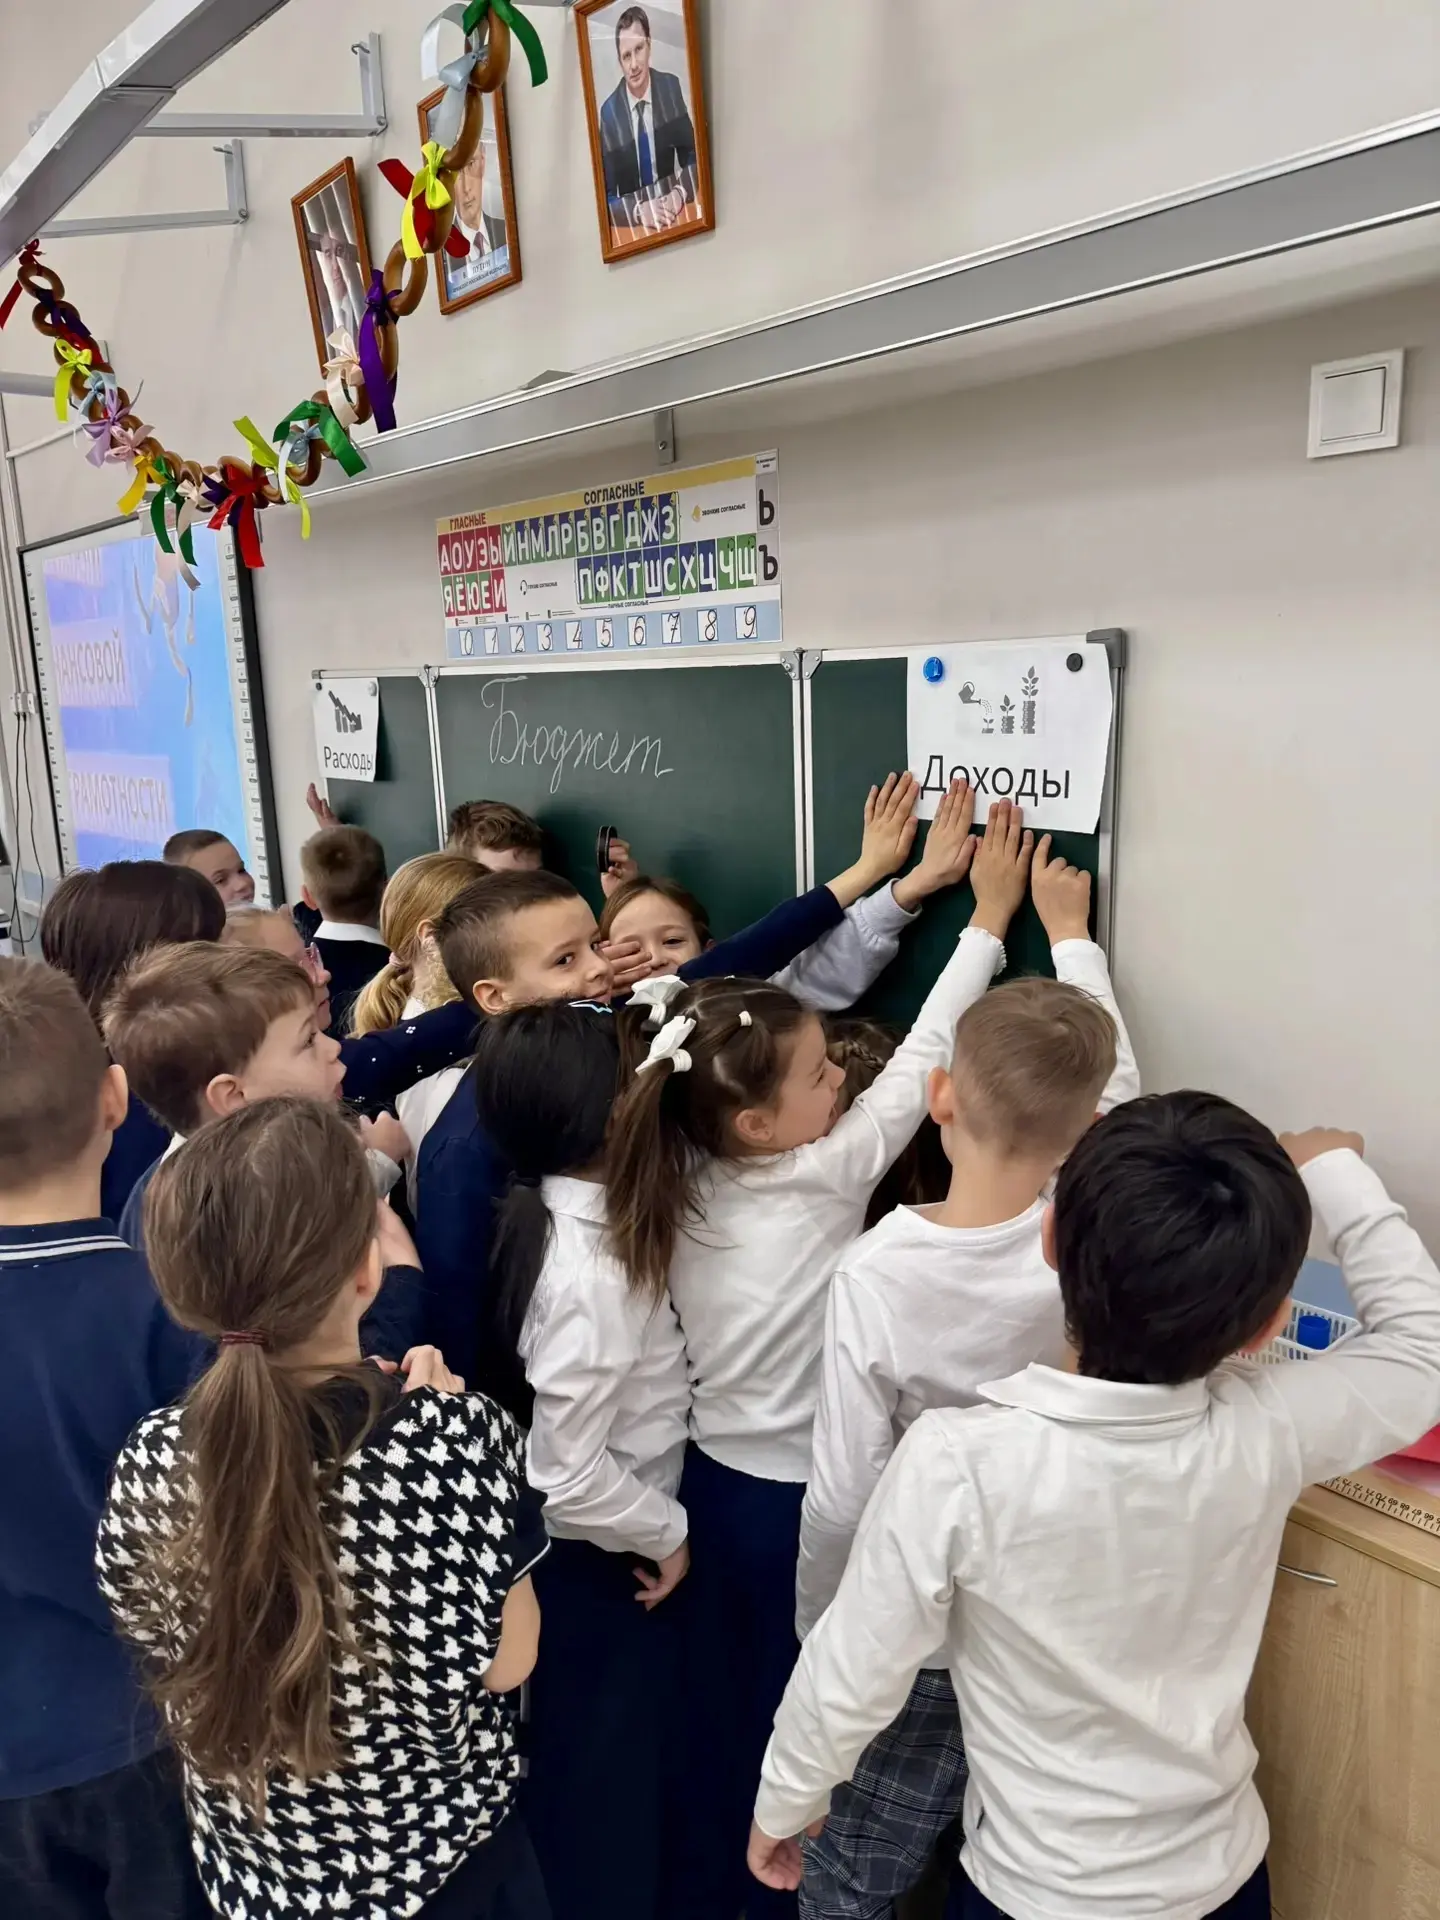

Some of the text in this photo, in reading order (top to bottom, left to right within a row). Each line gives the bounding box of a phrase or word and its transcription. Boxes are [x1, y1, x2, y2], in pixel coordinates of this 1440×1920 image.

[584, 481, 645, 506] СОГЛАСНЫЕ
[450, 513, 486, 530] ГЛАСНЫЕ
[702, 503, 746, 516] ЗВОНКИЕ СОГЛАСНЫЕ
[464, 606, 756, 655] 0 1 2 3 4 5 6 7 8 9
[481, 676, 674, 794] Бюджет
[324, 746, 373, 776] Расходы
[70, 772, 168, 824] РАМОТНОСТИ
[1375, 1492, 1387, 1502] 70
